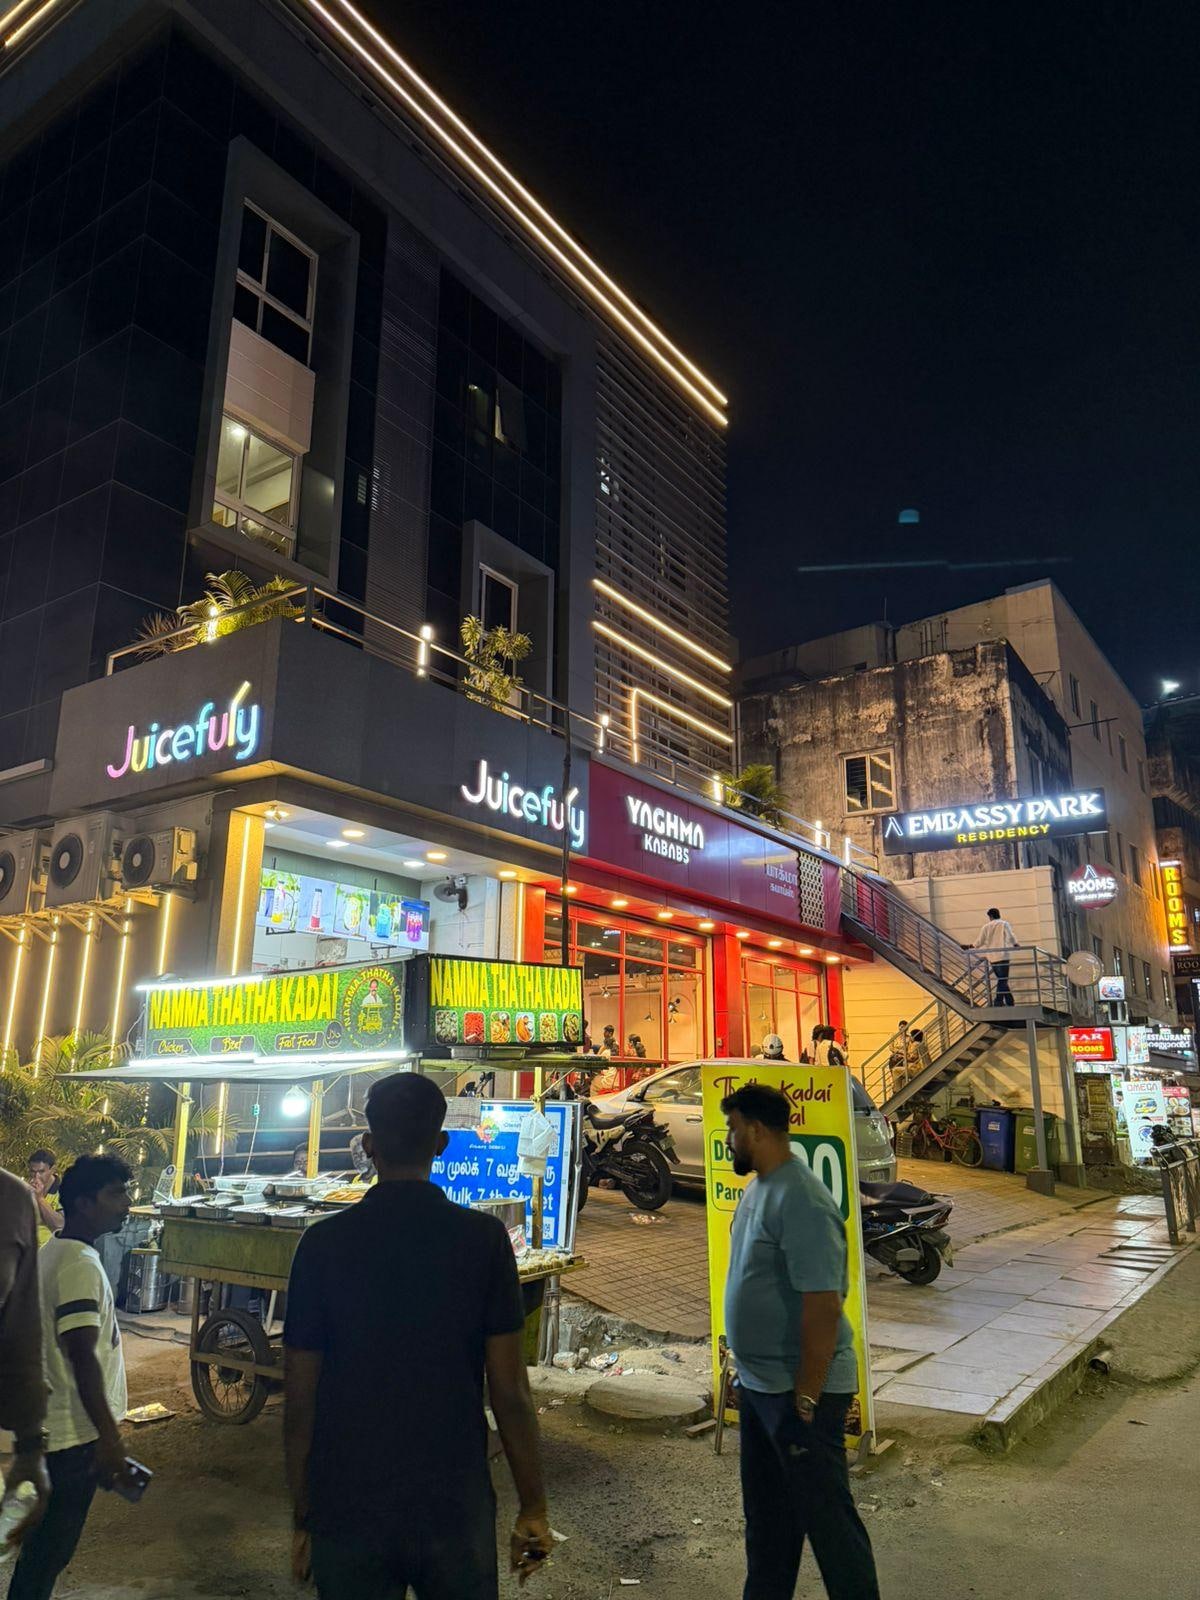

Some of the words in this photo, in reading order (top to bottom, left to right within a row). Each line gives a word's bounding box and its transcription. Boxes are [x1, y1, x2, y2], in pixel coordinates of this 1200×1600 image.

[626, 795, 704, 849] YAGHMA
[907, 803, 1024, 835] EMBASSY
[1026, 793, 1104, 822] PARK
[957, 823, 1050, 843] RESIDENCY
[643, 833, 690, 864] KABABS
[1068, 877, 1115, 894] ROOMS
[1163, 867, 1187, 945] ROOMS
[361, 968, 395, 986] THATHA
[431, 958, 490, 1007] NAMMA
[490, 963, 544, 1008] THATHA
[544, 966, 582, 1010] KADAI
[150, 987, 209, 1030] NAMMA
[211, 977, 277, 1027] THATHA
[279, 973, 339, 1022] KADAI
[279, 1034, 296, 1051] Fast
[297, 1031, 318, 1048] Food
[1069, 1033, 1103, 1041] TAR
[1146, 1033, 1191, 1041] ESTAURANT
[1070, 1045, 1105, 1053] ROOMS
[780, 1077, 833, 1109] Kadai
[486, 1158, 494, 1177] 7
